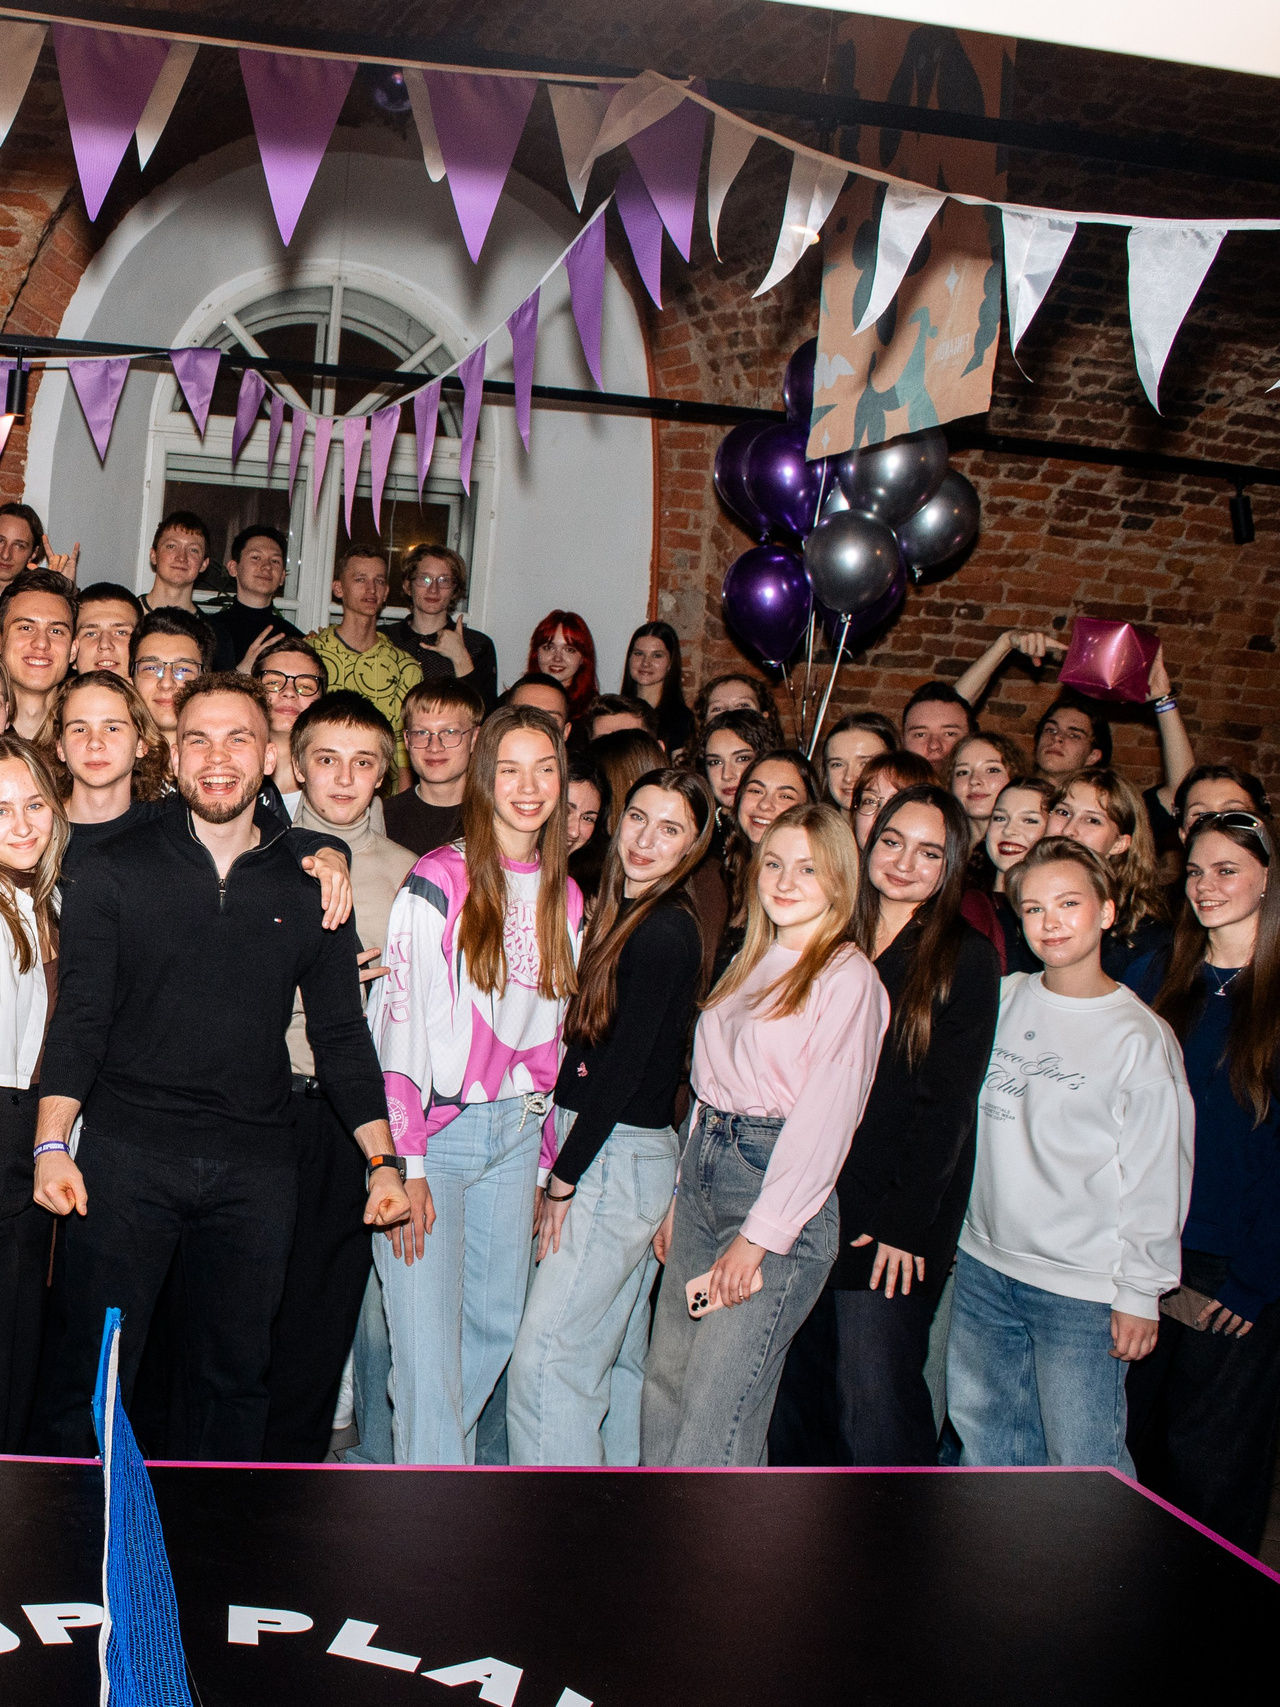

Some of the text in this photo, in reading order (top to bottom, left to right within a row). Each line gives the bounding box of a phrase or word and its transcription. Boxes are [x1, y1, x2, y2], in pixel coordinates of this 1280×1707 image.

[983, 1062, 1029, 1098] Club
[991, 1043, 1086, 1091] ecco Girl's
[227, 1604, 594, 1707] PLA
